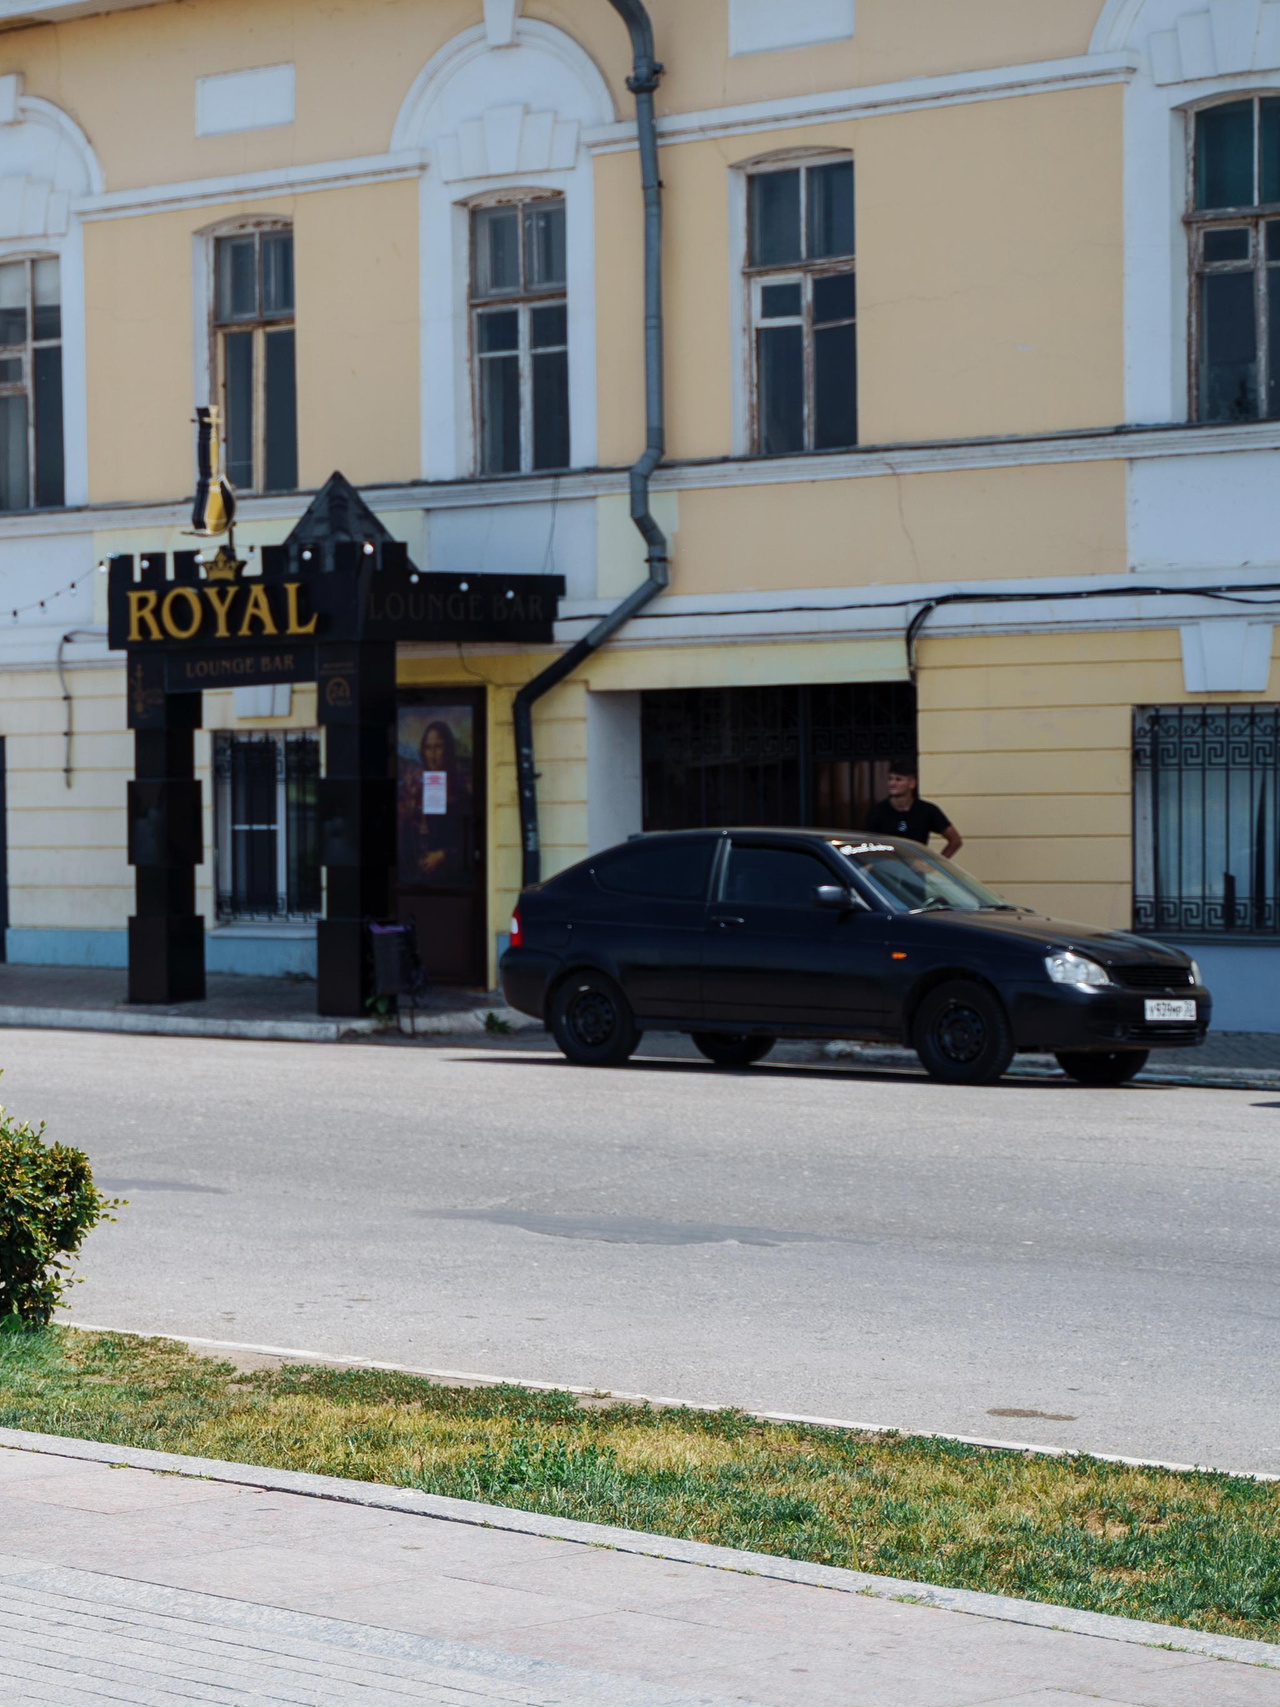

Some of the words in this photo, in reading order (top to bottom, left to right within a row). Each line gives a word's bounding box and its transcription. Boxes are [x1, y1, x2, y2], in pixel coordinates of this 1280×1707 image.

[126, 582, 318, 642] ROYAL
[369, 592, 484, 622] LOUNGE
[493, 594, 543, 622] BAR
[185, 657, 256, 678] LOUNGE
[261, 654, 295, 673] BAR
